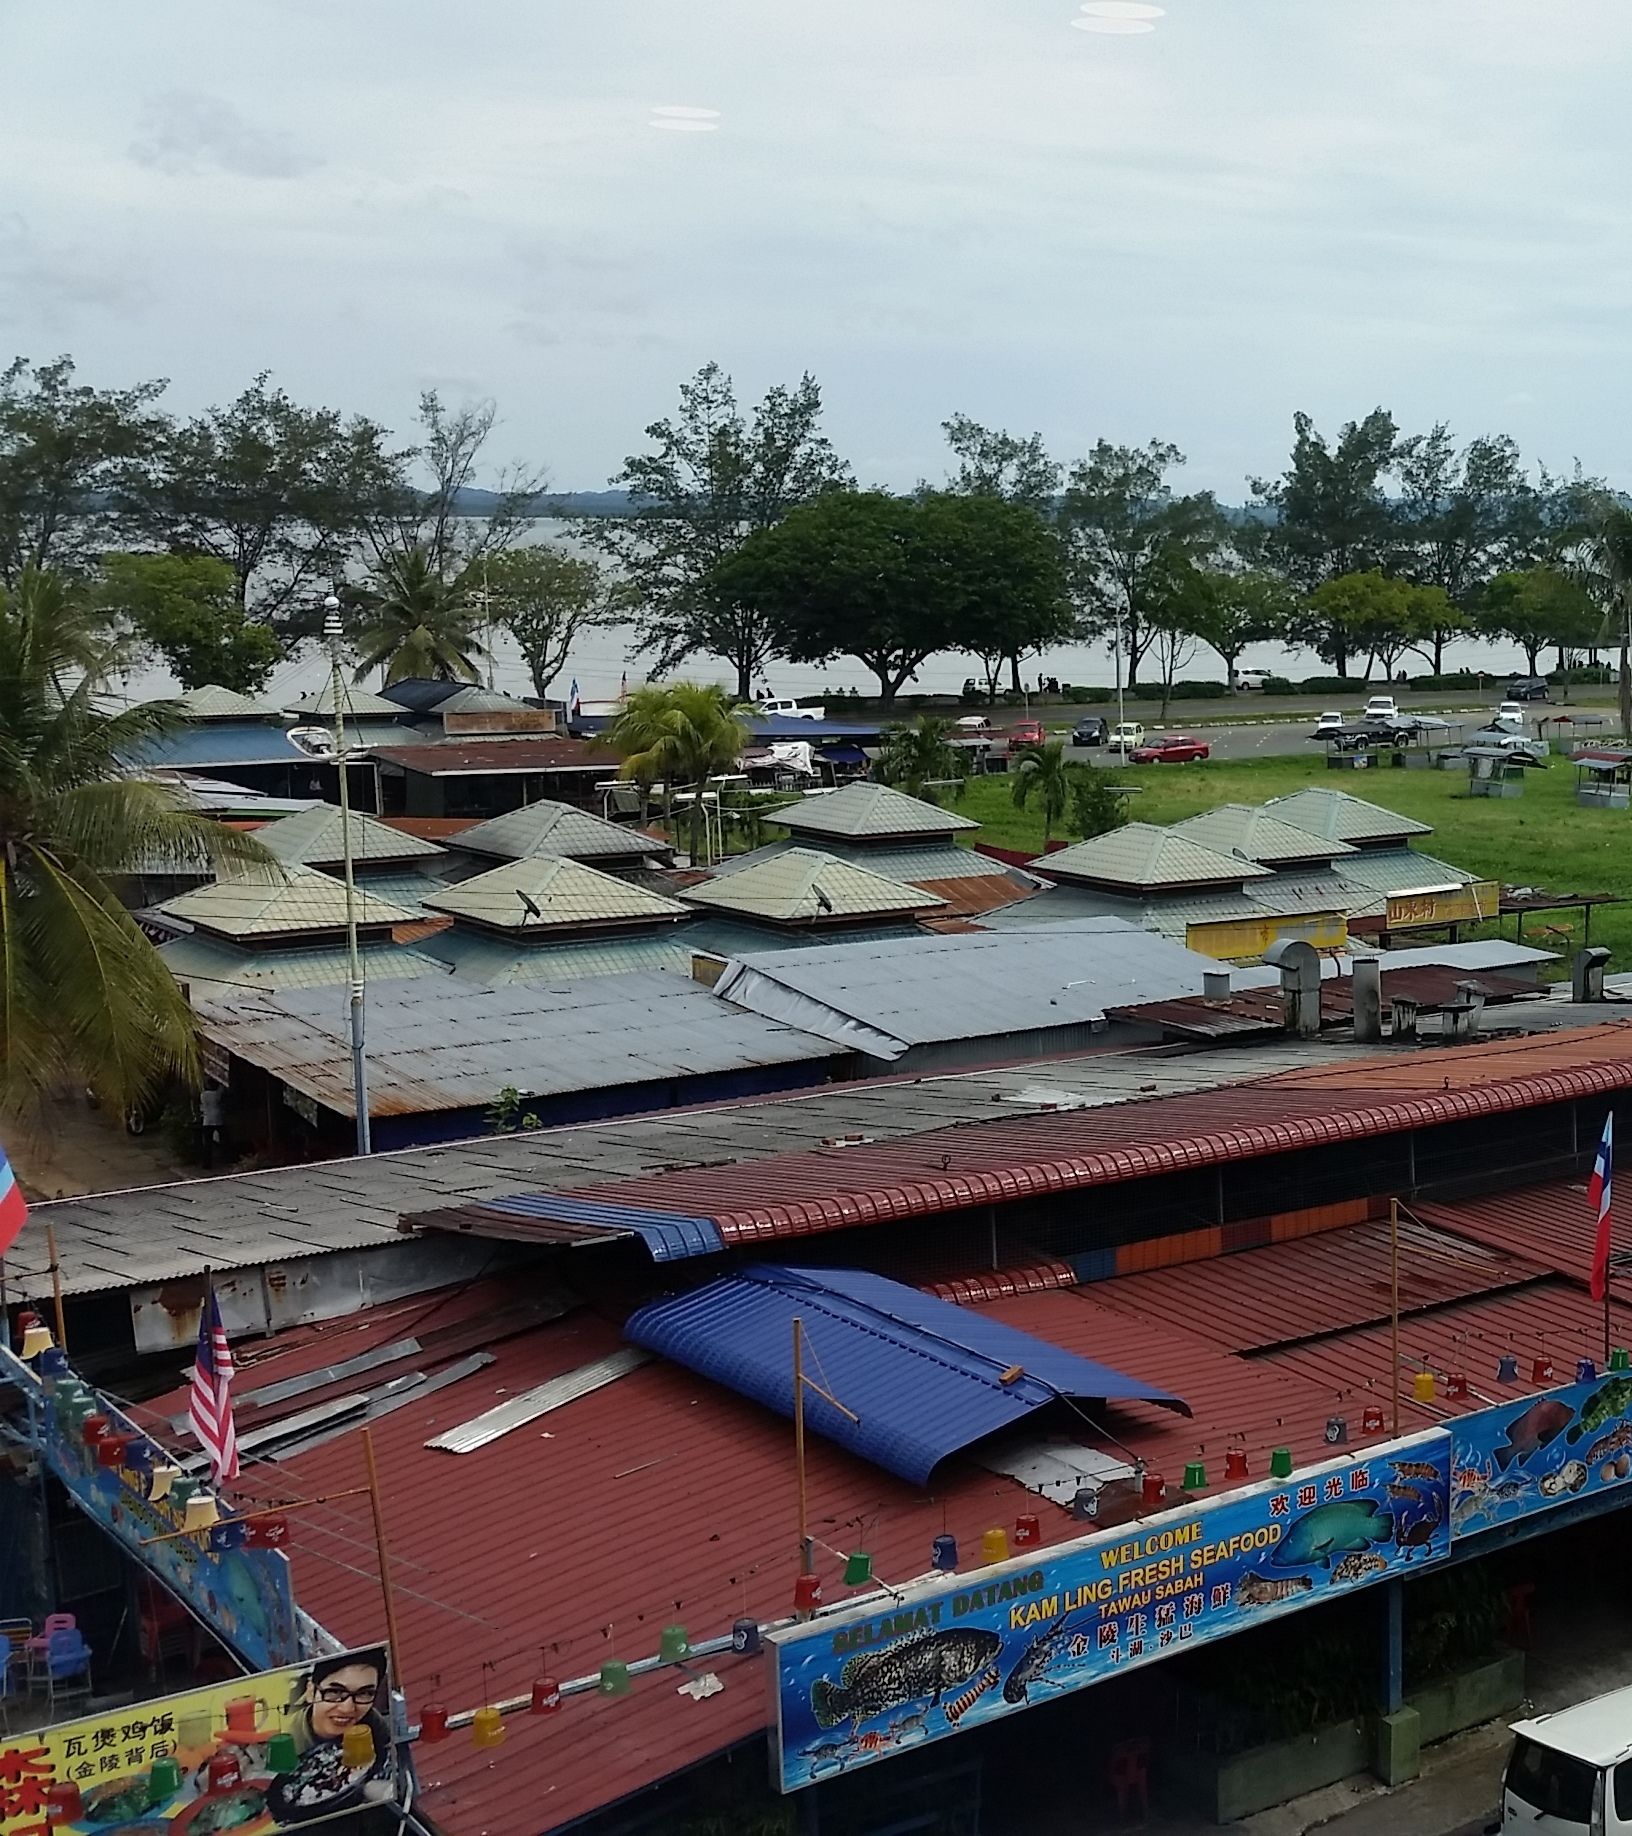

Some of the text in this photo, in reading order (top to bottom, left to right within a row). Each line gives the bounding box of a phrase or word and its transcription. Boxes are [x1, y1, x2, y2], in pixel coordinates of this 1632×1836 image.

[1270, 1468, 1369, 1517] 欢迎光临
[1101, 1520, 1203, 1570] WELCOME
[1010, 1523, 1282, 1630] KAM LING FRESH SEAFOOD
[1099, 1571, 1204, 1620] TAWAU SABAH
[832, 1570, 1045, 1655] SELAMAT DATANG
[63, 1711, 176, 1759] 瓦煲鸡饭
